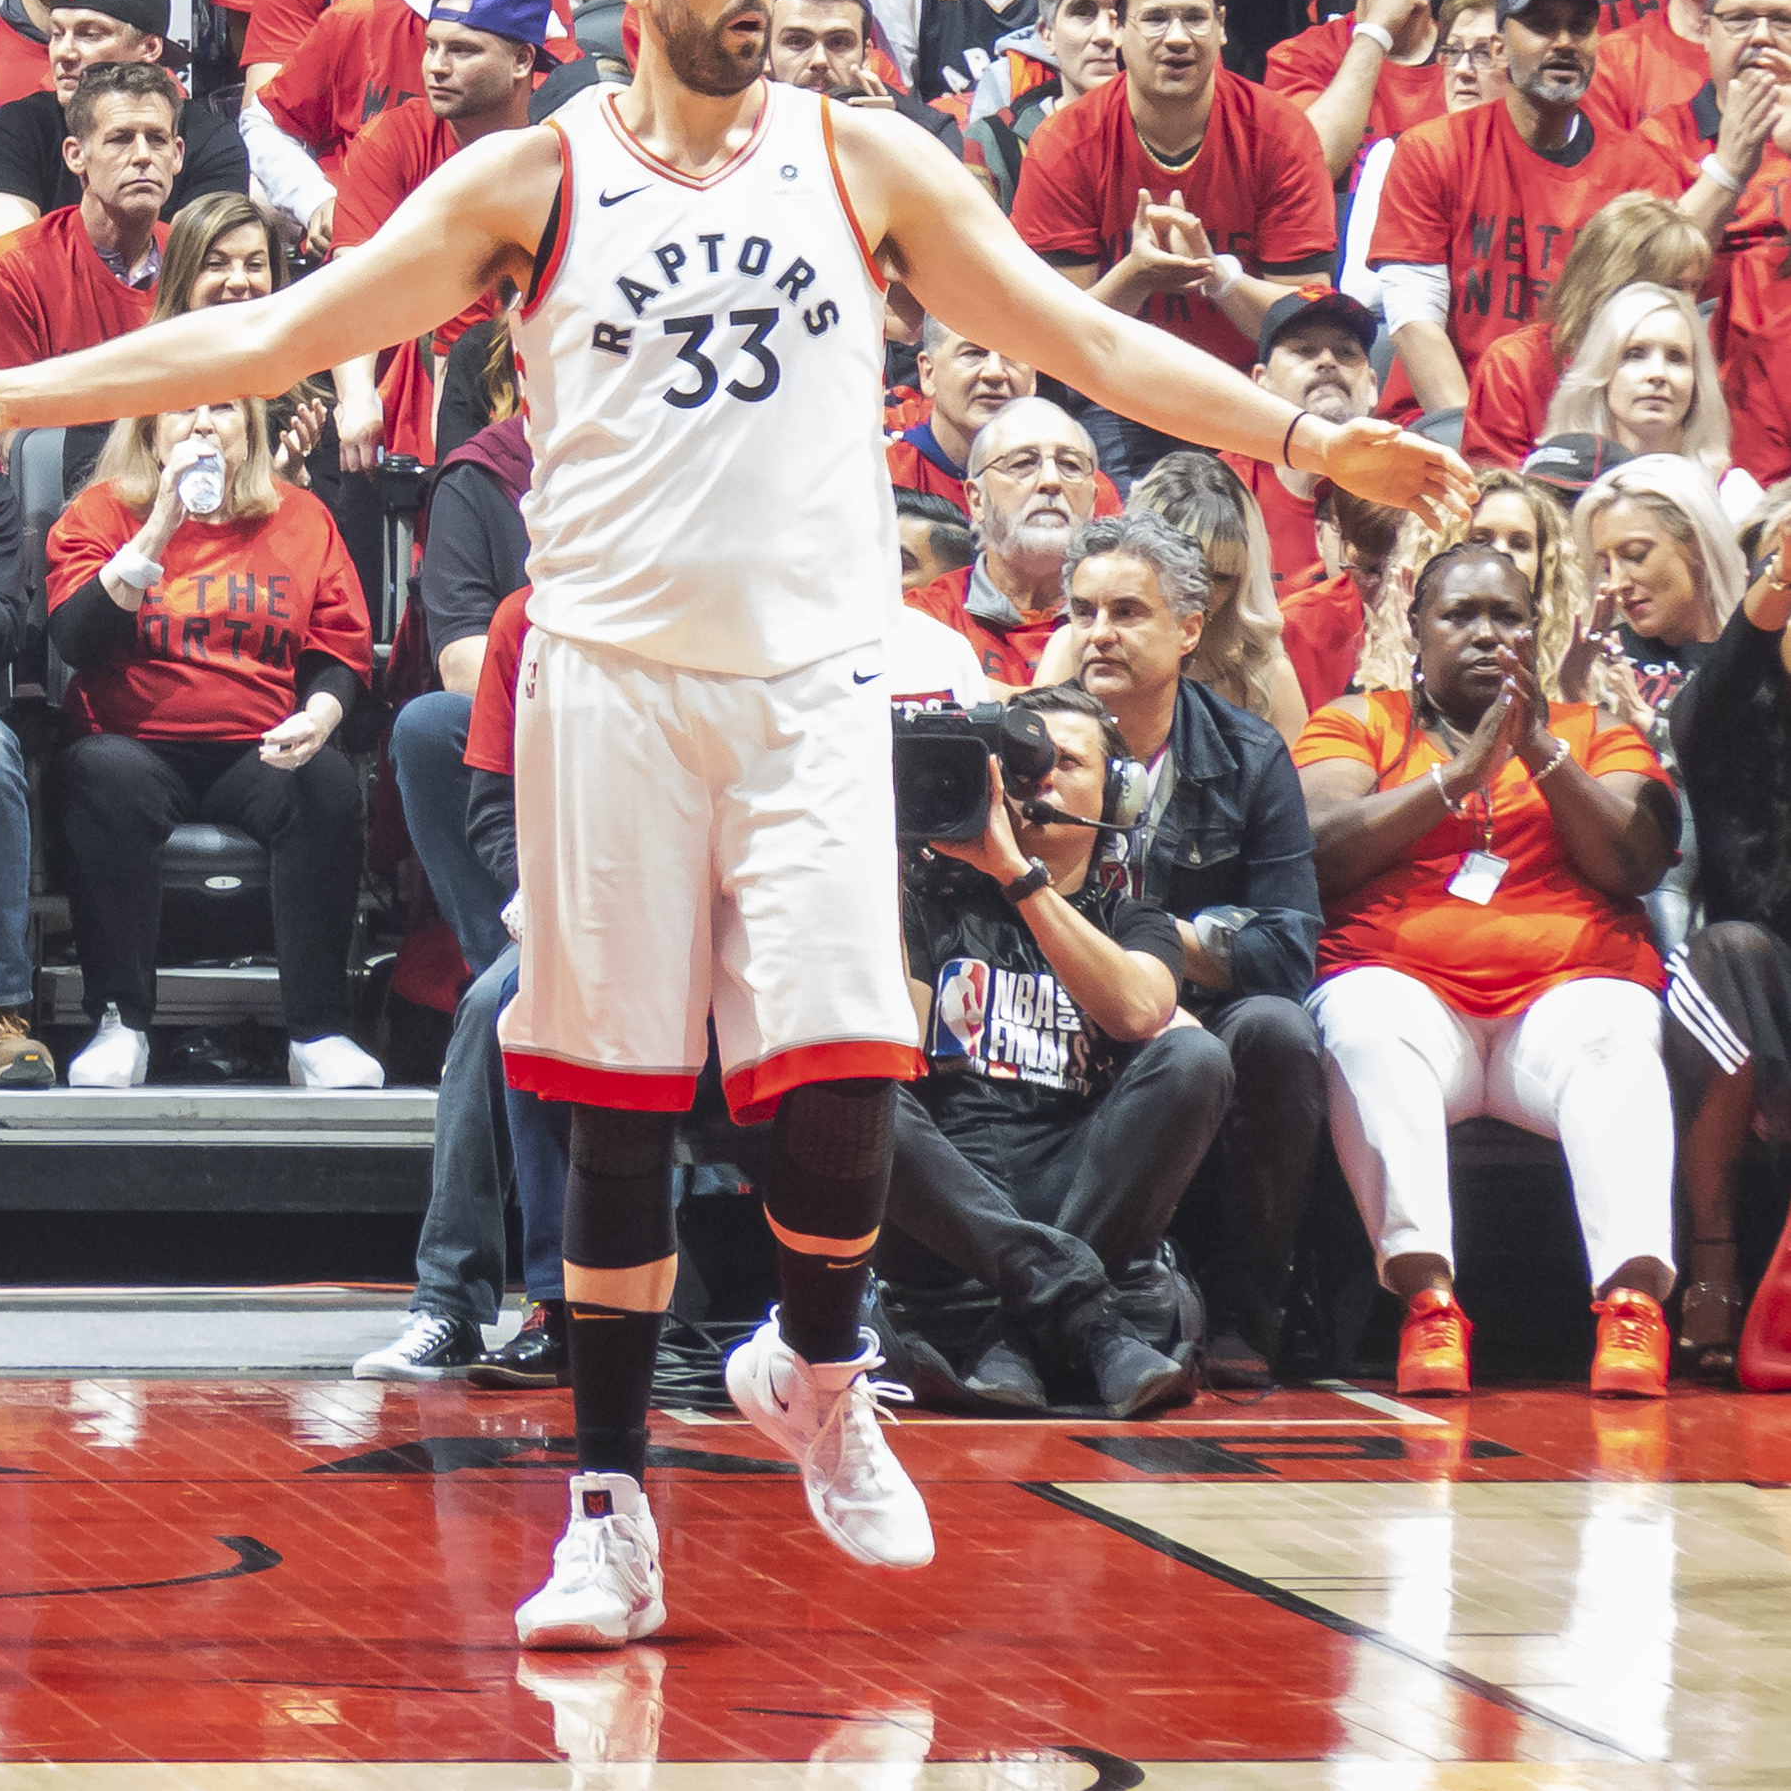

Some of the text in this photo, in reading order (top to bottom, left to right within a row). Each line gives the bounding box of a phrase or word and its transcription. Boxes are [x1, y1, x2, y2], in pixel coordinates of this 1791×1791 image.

[1469, 215, 1523, 263] WE
[591, 232, 841, 354] RAPTORS
[663, 306, 781, 410] 33
[194, 573, 292, 619] THE
[143, 615, 295, 670] ORTH
[991, 970, 1057, 1031] NBA
[989, 1019, 1091, 1071] FINALS
